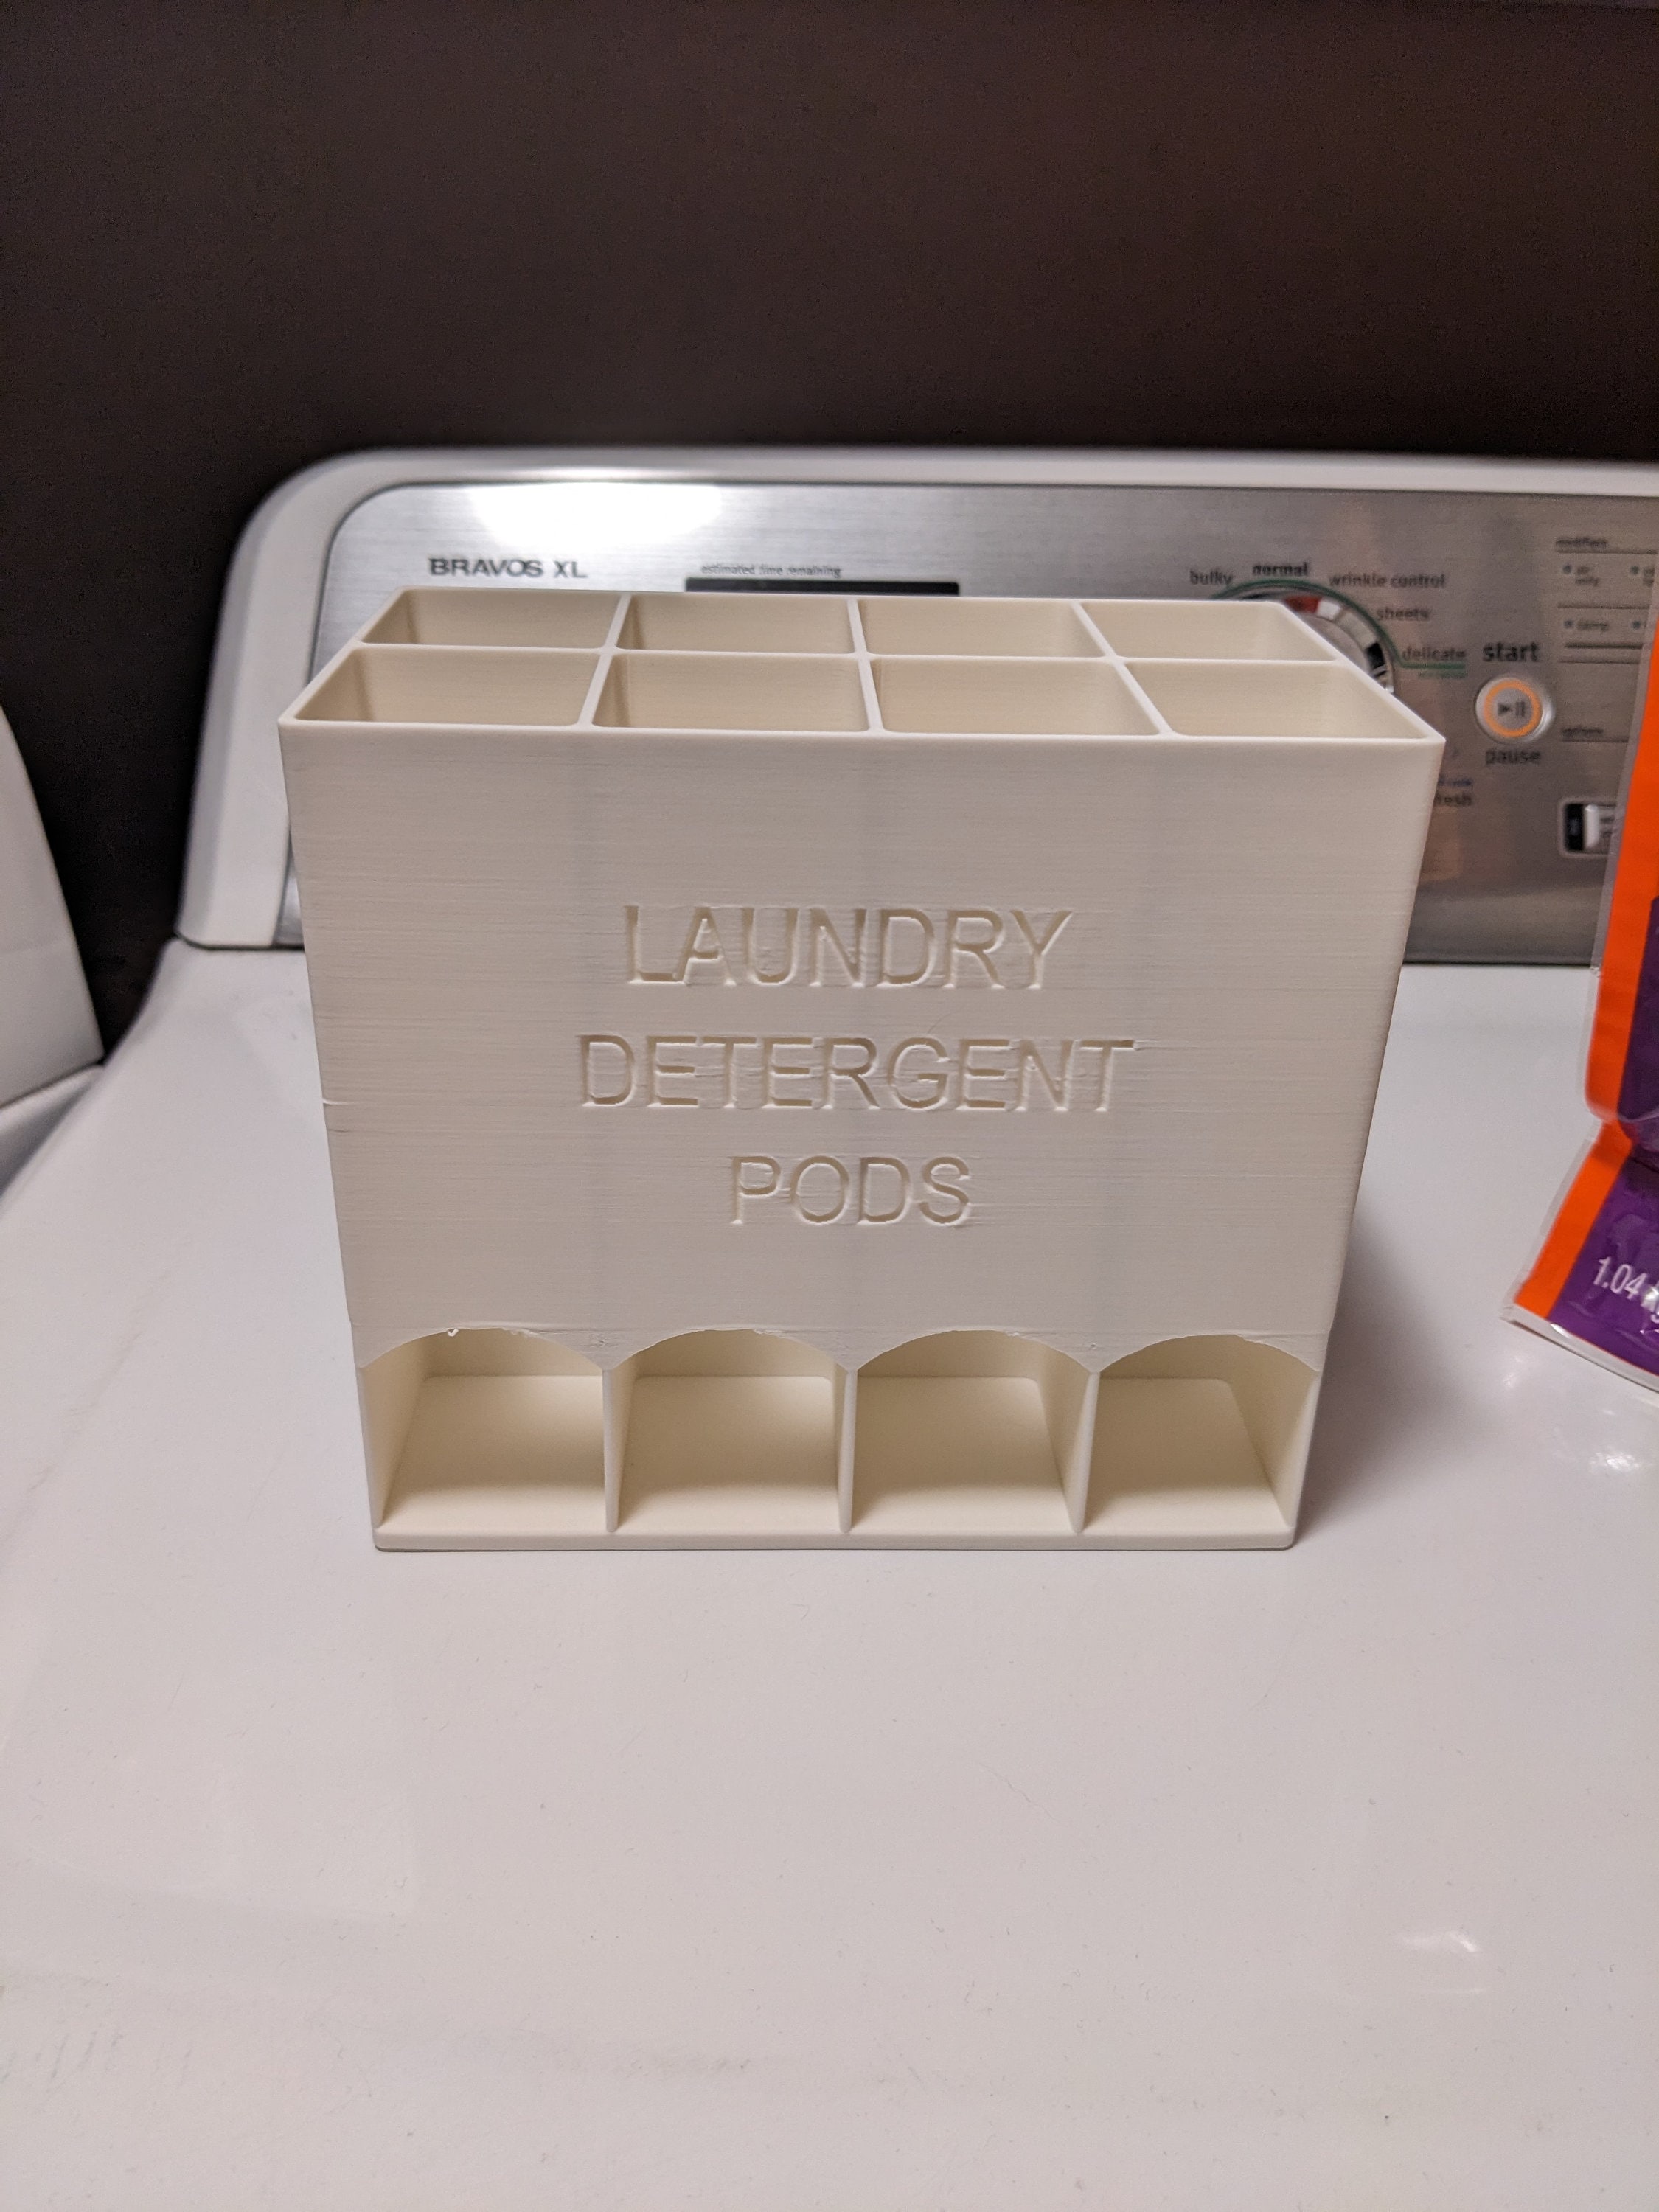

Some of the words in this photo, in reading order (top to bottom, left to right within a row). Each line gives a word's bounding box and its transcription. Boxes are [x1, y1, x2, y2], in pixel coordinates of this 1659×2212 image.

[429, 558, 544, 577] BRAVOS
[554, 560, 588, 578] XL
[701, 563, 755, 575] estimated
[759, 564, 783, 576] time
[788, 565, 842, 579] remaining
[1189, 568, 1234, 587] bulky
[1252, 562, 1309, 577] normal
[1329, 573, 1386, 588] wrinkle
[1390, 573, 1446, 588] control
[1377, 606, 1431, 621] sheets
[1402, 646, 1466, 661] delicate
[1482, 641, 1539, 662] start
[1485, 749, 1541, 767] pause
[624, 904, 1074, 989] LAUNDRY
[579, 1034, 1135, 1111] DETERGENT
[729, 1155, 973, 1227] PODS
[1593, 1256, 1648, 1301] 1.04
